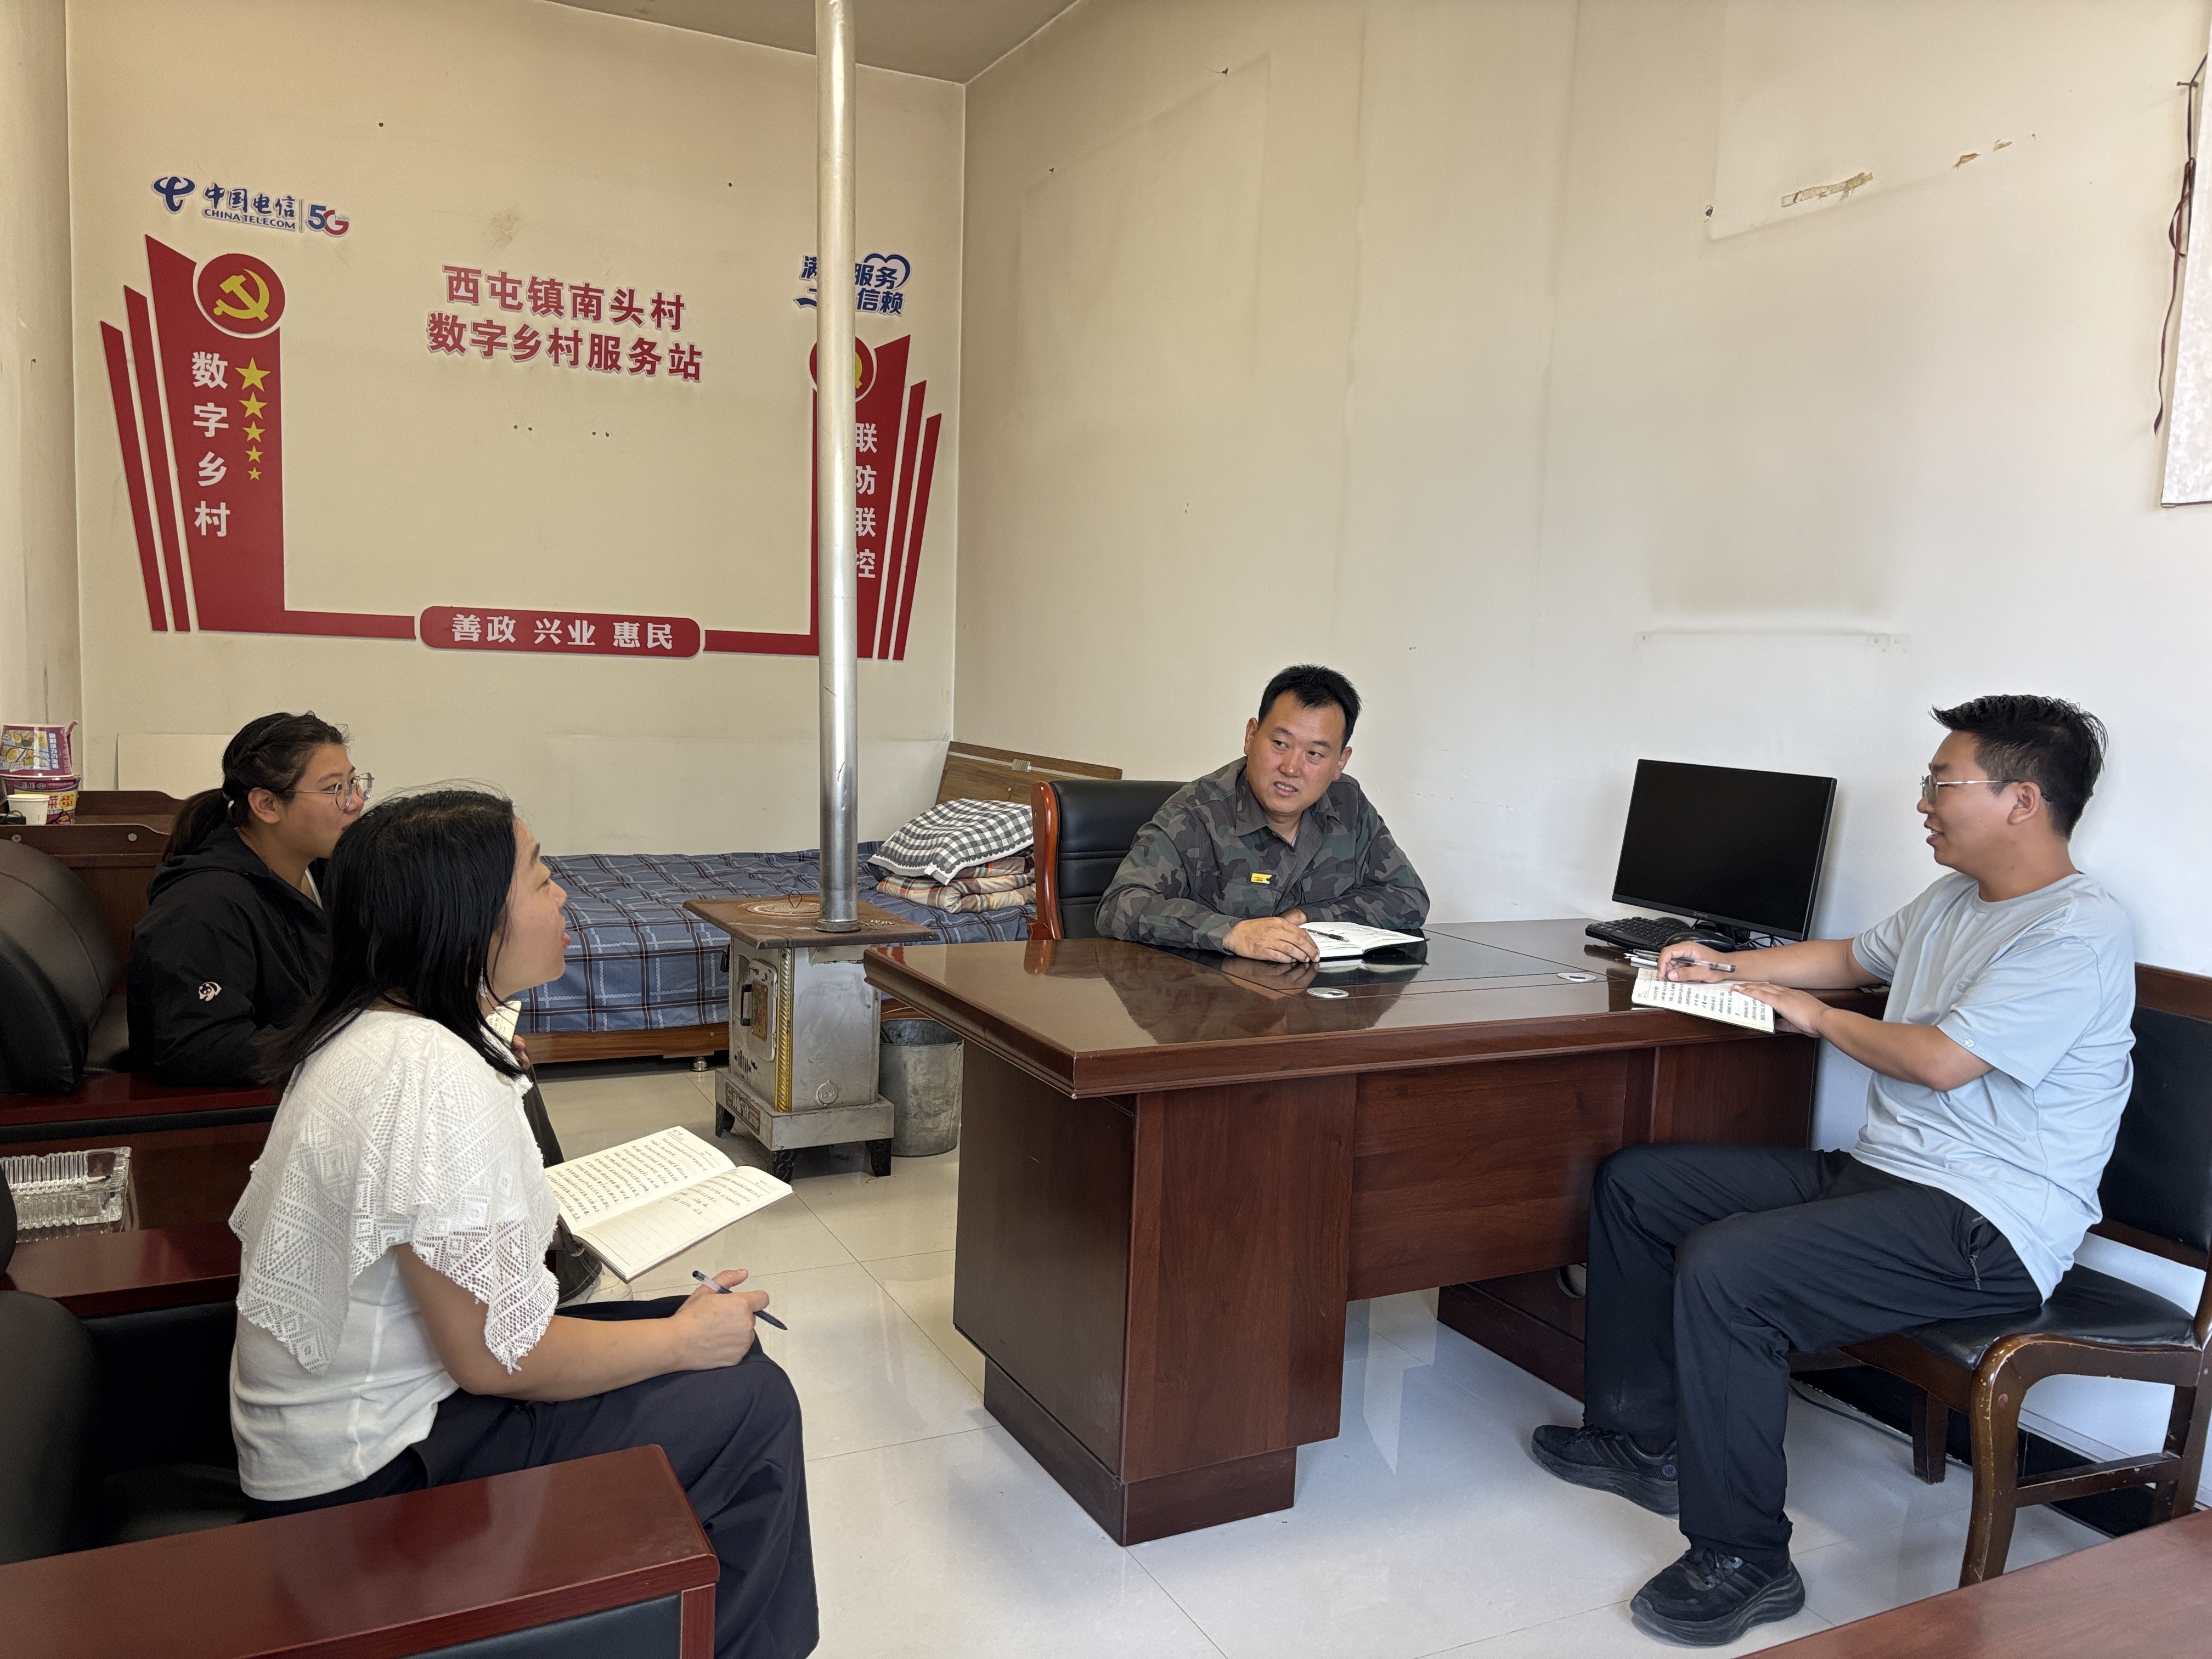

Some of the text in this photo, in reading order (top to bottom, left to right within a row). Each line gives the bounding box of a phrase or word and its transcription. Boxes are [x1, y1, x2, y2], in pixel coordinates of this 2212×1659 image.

[204, 208, 295, 229] CHINA TELECOM
[205, 182, 296, 218] 中国电信
[307, 204, 349, 235] 5G
[800, 256, 898, 290] 满服务
[443, 265, 685, 331] 西屯镇南头村
[428, 312, 702, 381] 数字乡村服务站
[192, 351, 230, 537] 数字乡村
[855, 422, 878, 578] 联防联控
[451, 613, 674, 650] 善政 兴业 惠民
